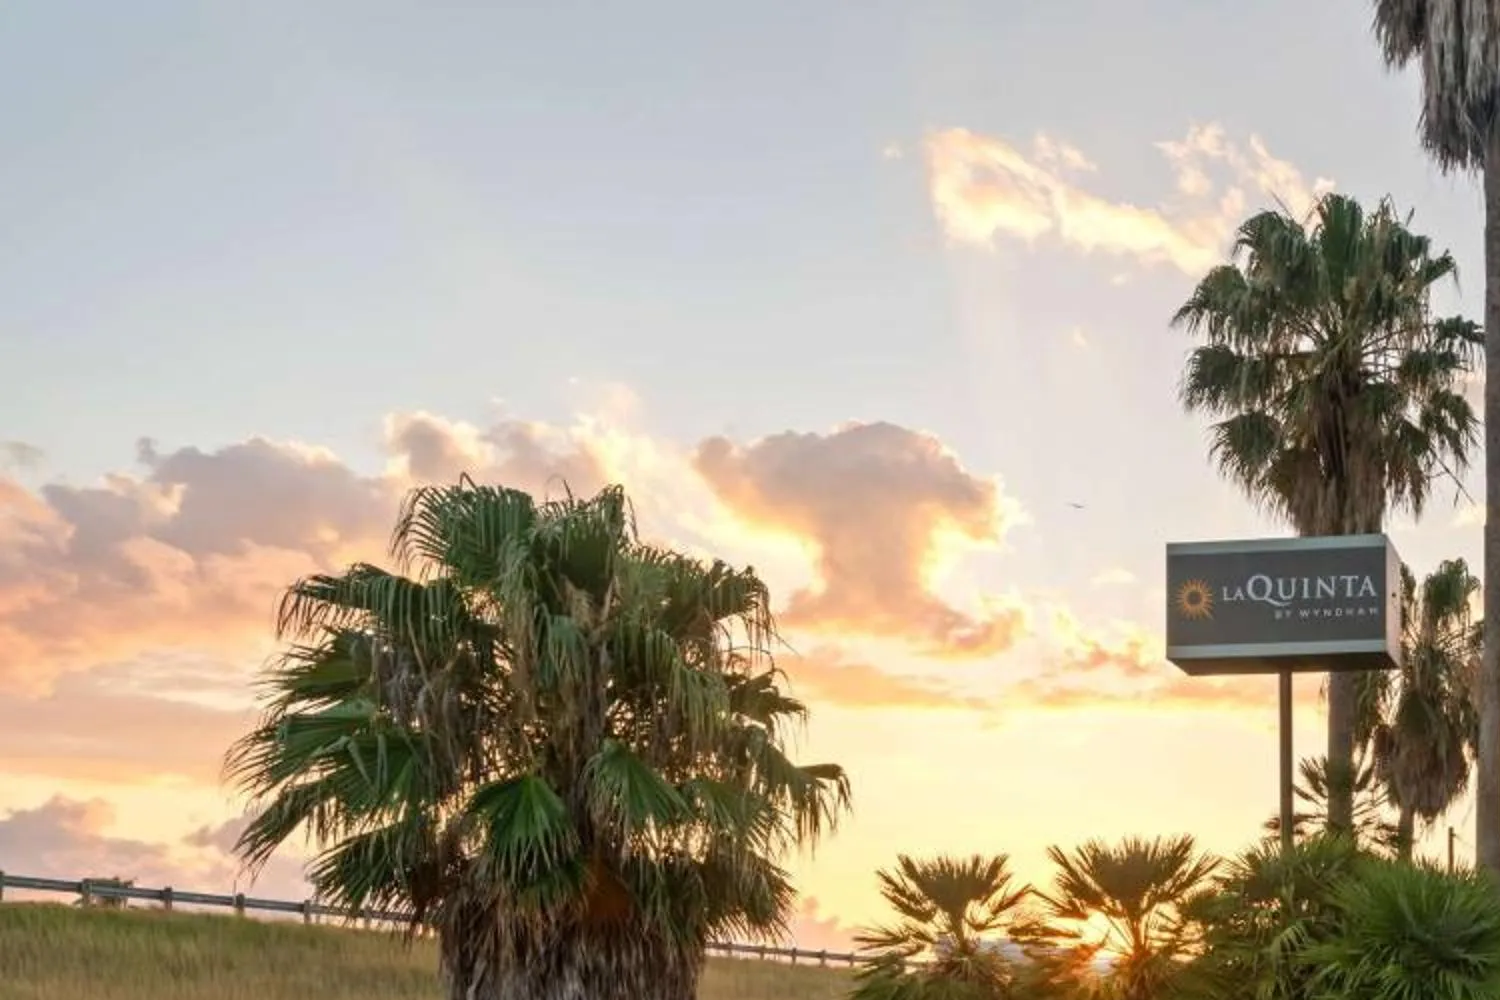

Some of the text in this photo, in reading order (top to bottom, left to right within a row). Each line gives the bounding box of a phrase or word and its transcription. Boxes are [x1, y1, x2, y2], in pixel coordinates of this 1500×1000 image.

[1246, 574, 1377, 607] QUINTA
[1274, 607, 1379, 620] BY WYNDHAM
